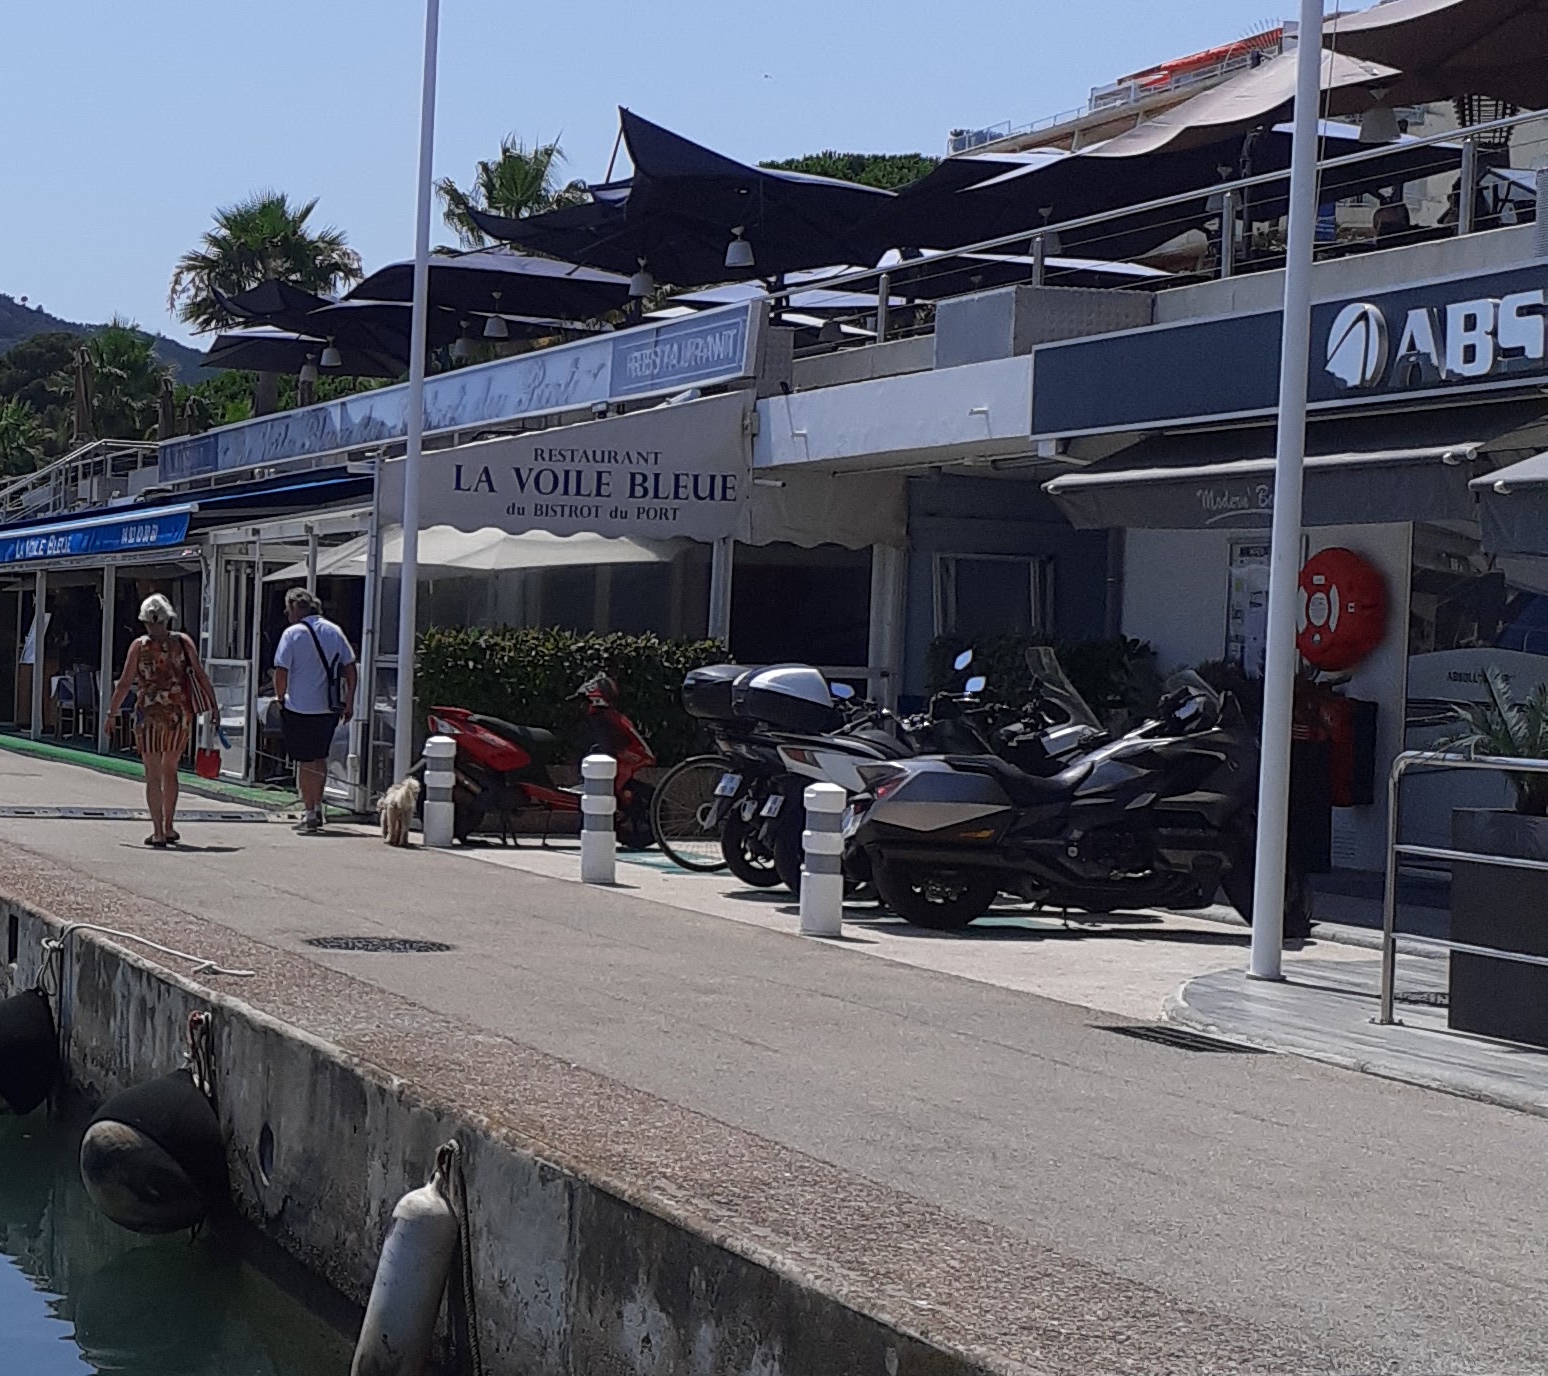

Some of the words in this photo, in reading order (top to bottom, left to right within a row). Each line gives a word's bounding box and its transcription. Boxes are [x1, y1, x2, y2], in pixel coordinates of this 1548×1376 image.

[1391, 289, 1544, 384] ABS
[533, 448, 662, 466] RESTAURANT
[454, 464, 498, 493] LA
[512, 467, 612, 497] VOILE
[627, 471, 737, 502] BLEUE
[506, 503, 526, 517] du
[534, 504, 602, 519] BISTROT
[609, 506, 628, 520] du
[636, 506, 680, 521] PORT
